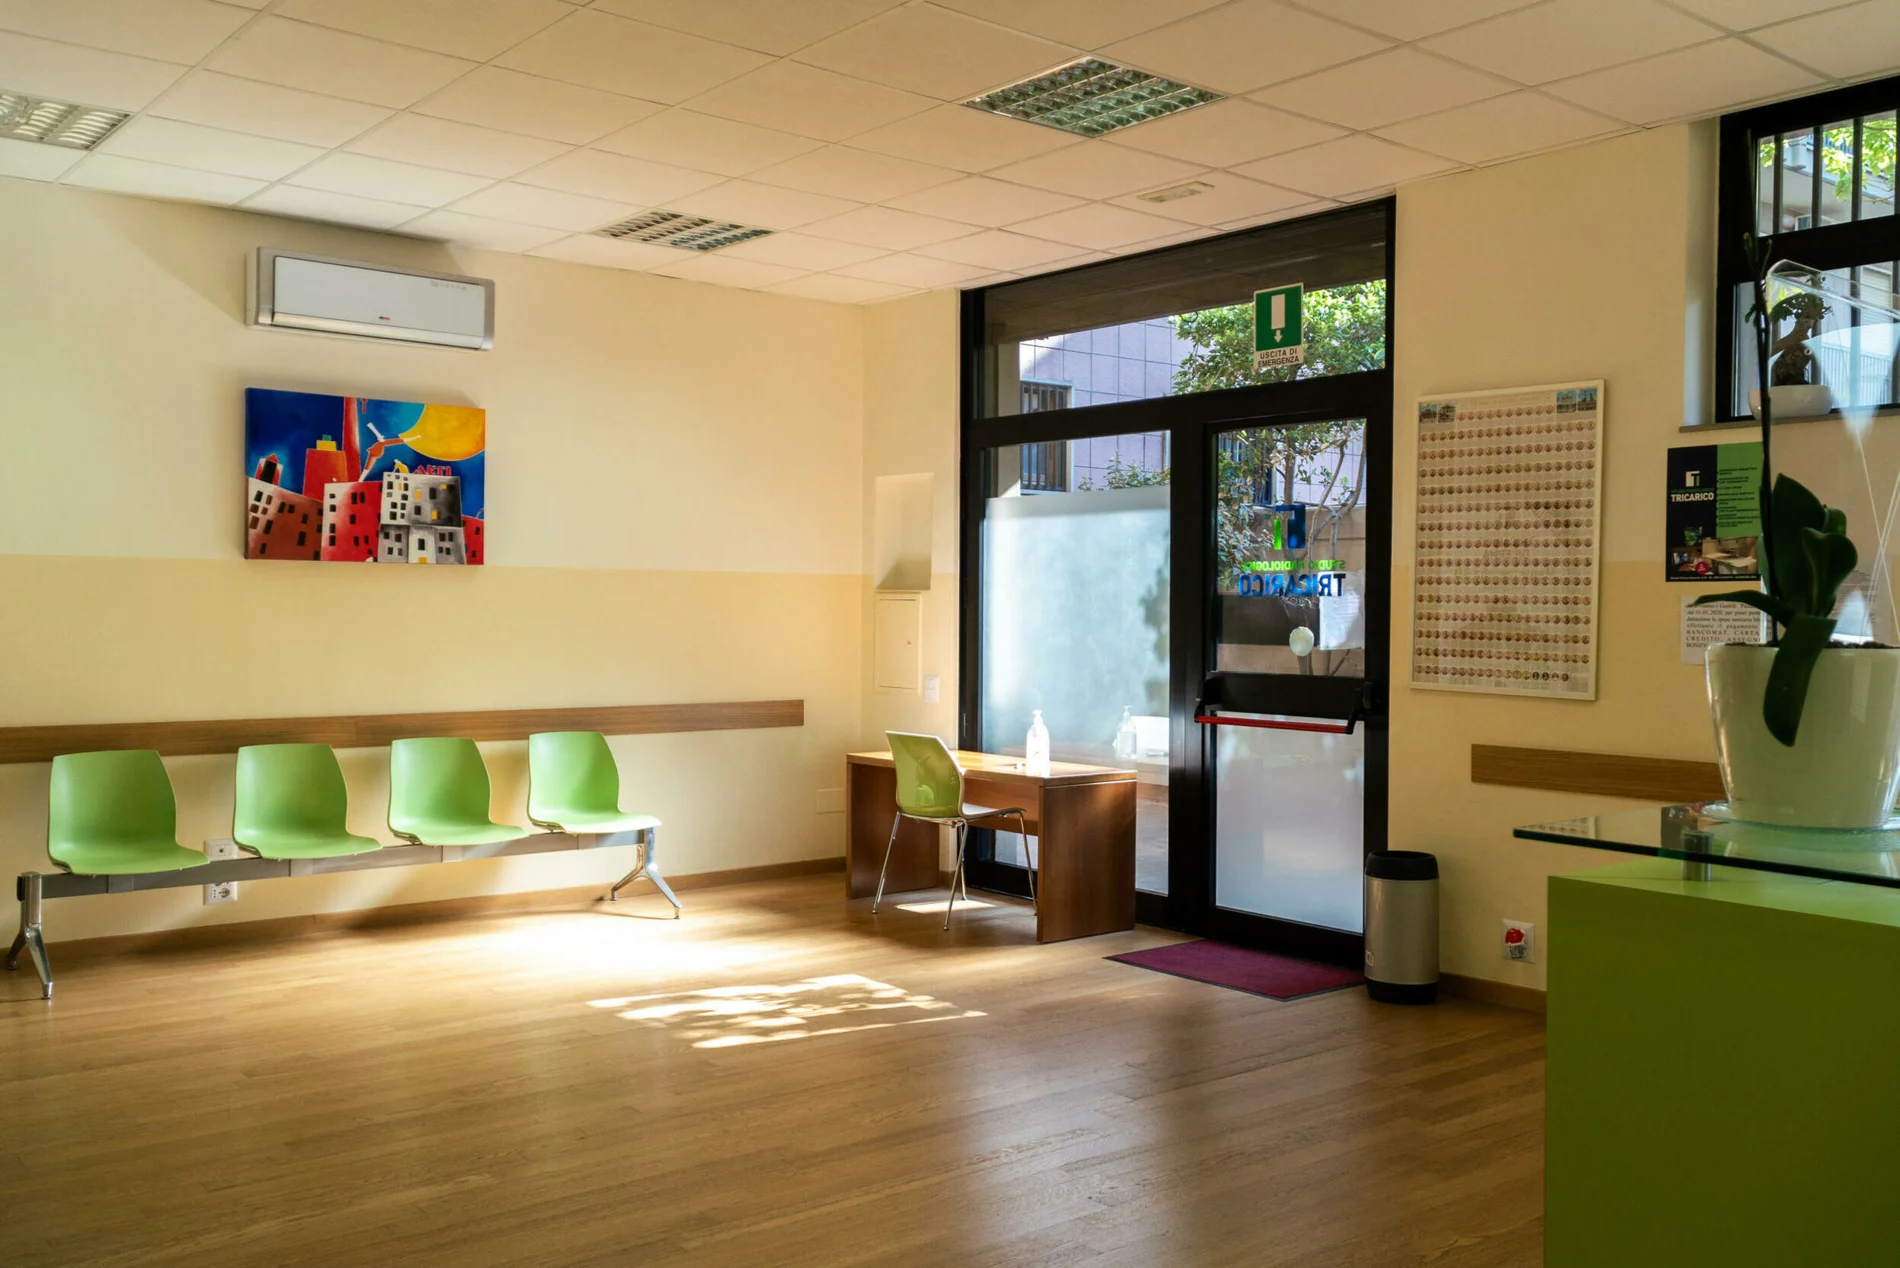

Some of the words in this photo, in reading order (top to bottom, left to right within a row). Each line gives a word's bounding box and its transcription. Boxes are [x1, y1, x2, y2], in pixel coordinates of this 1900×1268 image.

[1260, 350, 1286, 360] USCITA
[1258, 356, 1299, 368] EMERGENZA
[1671, 493, 1714, 502] TRICARICO
